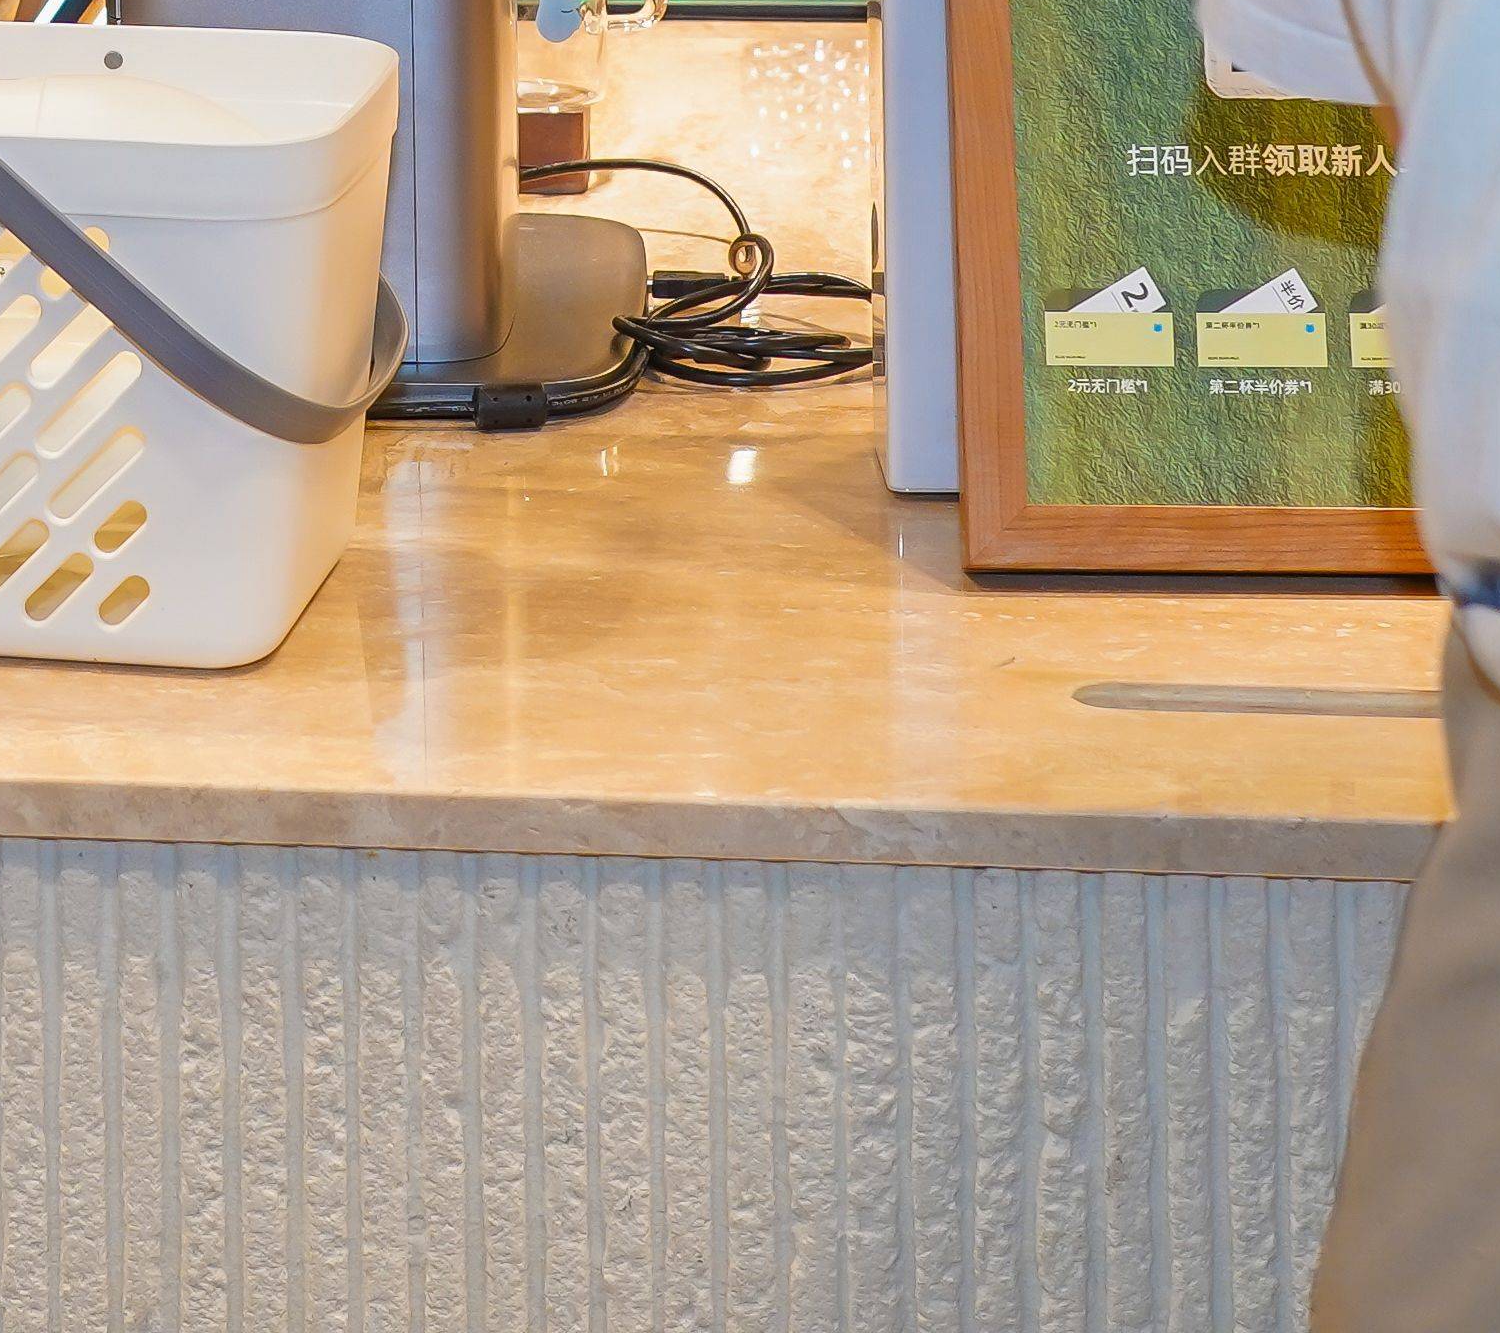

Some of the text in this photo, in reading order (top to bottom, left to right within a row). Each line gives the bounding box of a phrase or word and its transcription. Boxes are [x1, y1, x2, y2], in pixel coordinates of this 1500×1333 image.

[1126, 143, 1399, 178] 扫码入群领取新人
[1280, 279, 1305, 311] 半价
